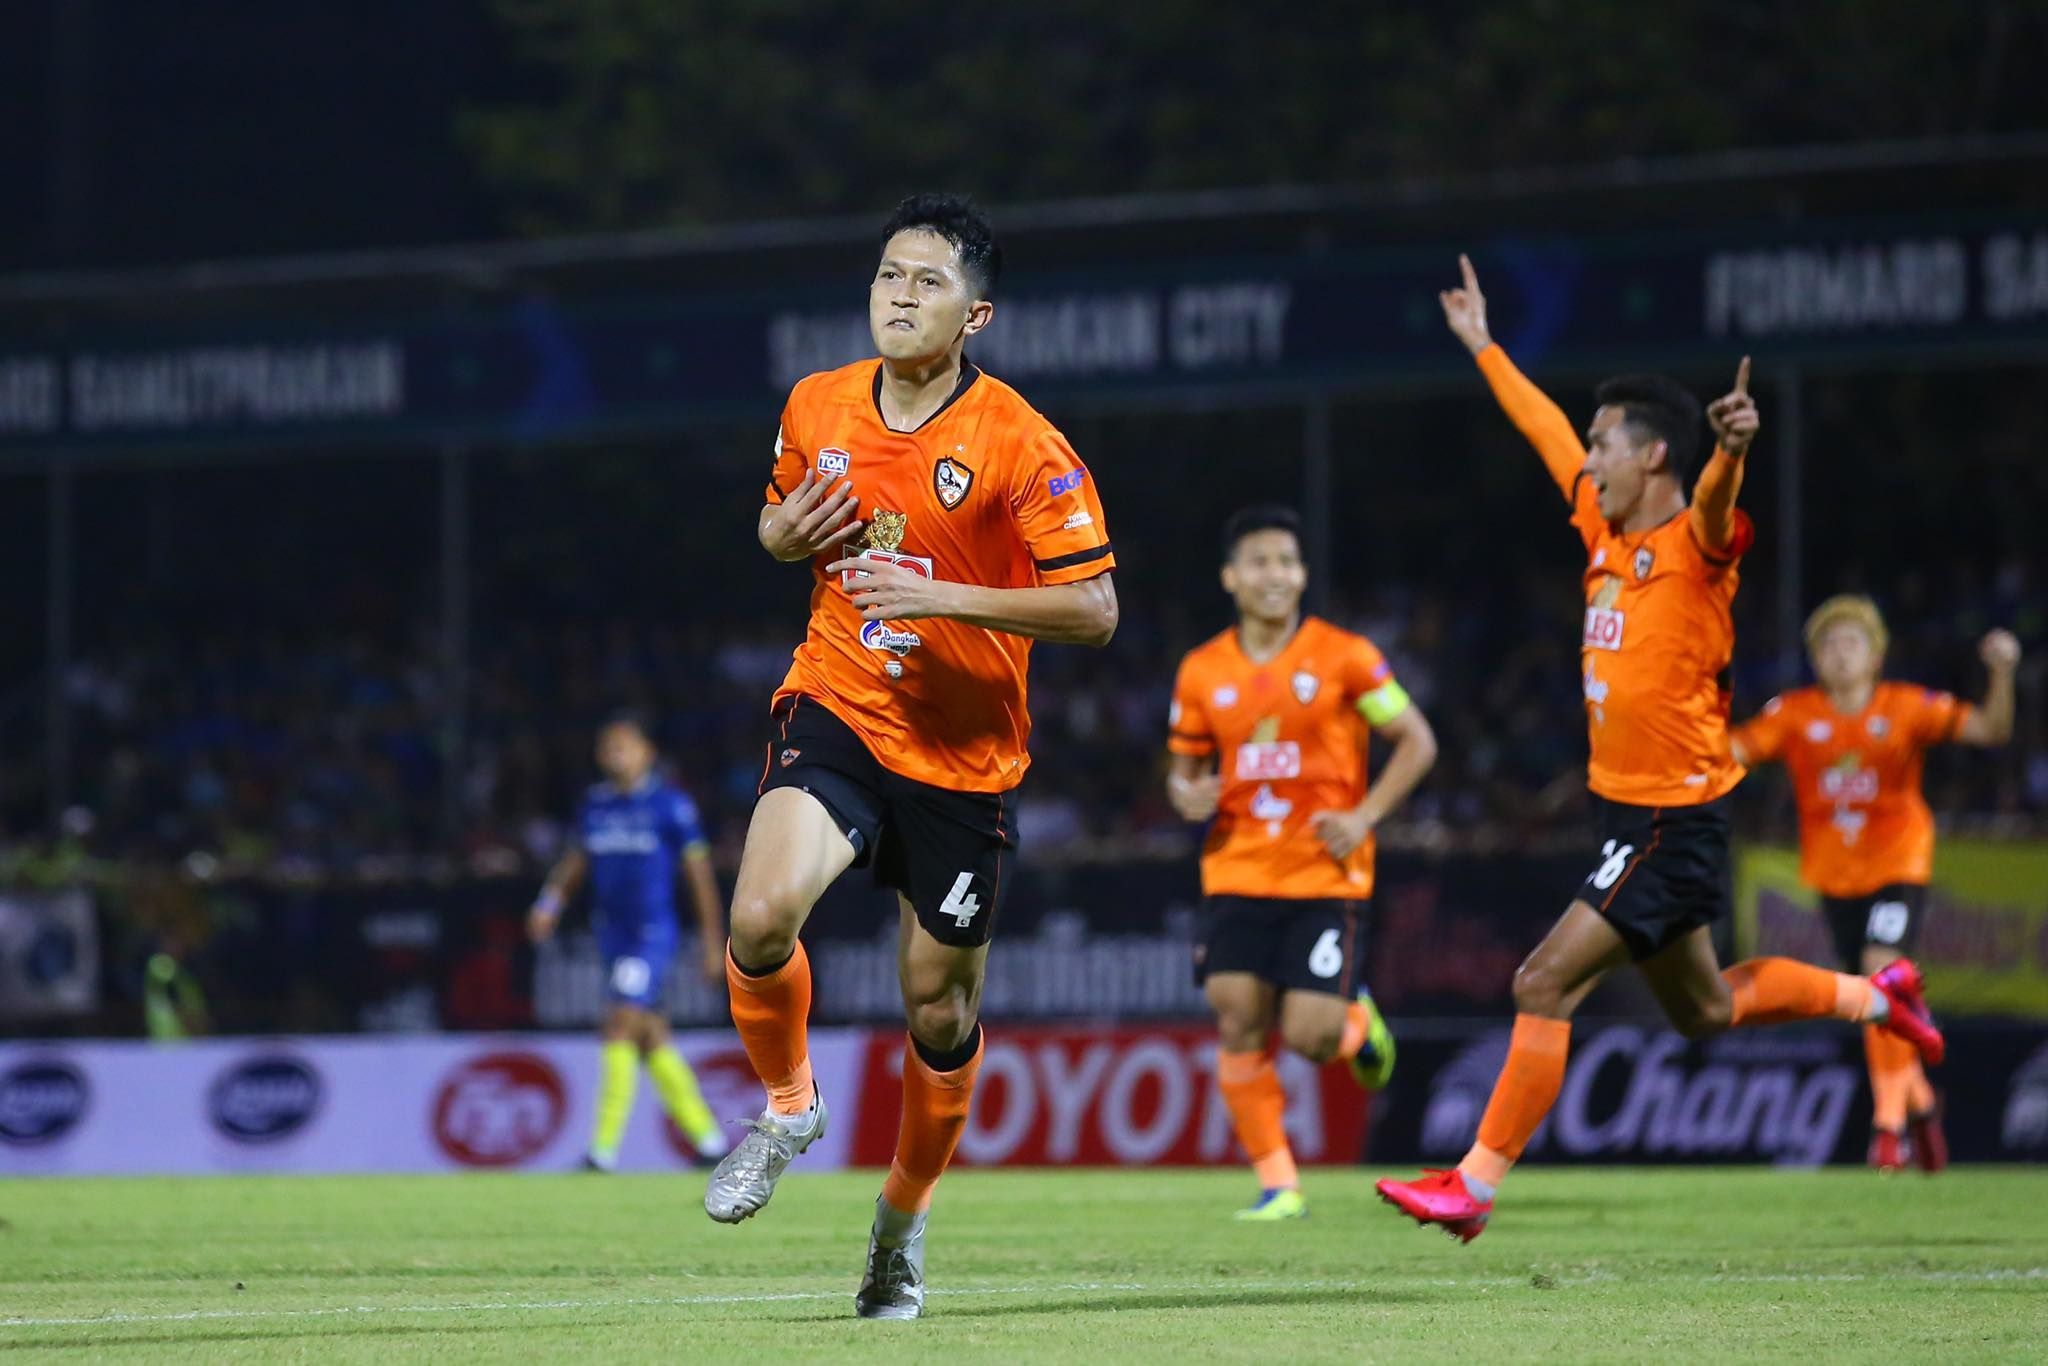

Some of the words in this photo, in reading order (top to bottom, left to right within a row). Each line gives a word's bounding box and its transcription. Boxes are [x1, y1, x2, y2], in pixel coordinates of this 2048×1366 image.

[820, 455, 847, 473] TOA
[884, 629, 920, 646] Bangkok
[938, 871, 982, 928] 4
[1308, 928, 1343, 979] 6
[1555, 1025, 1856, 1168] Chang
